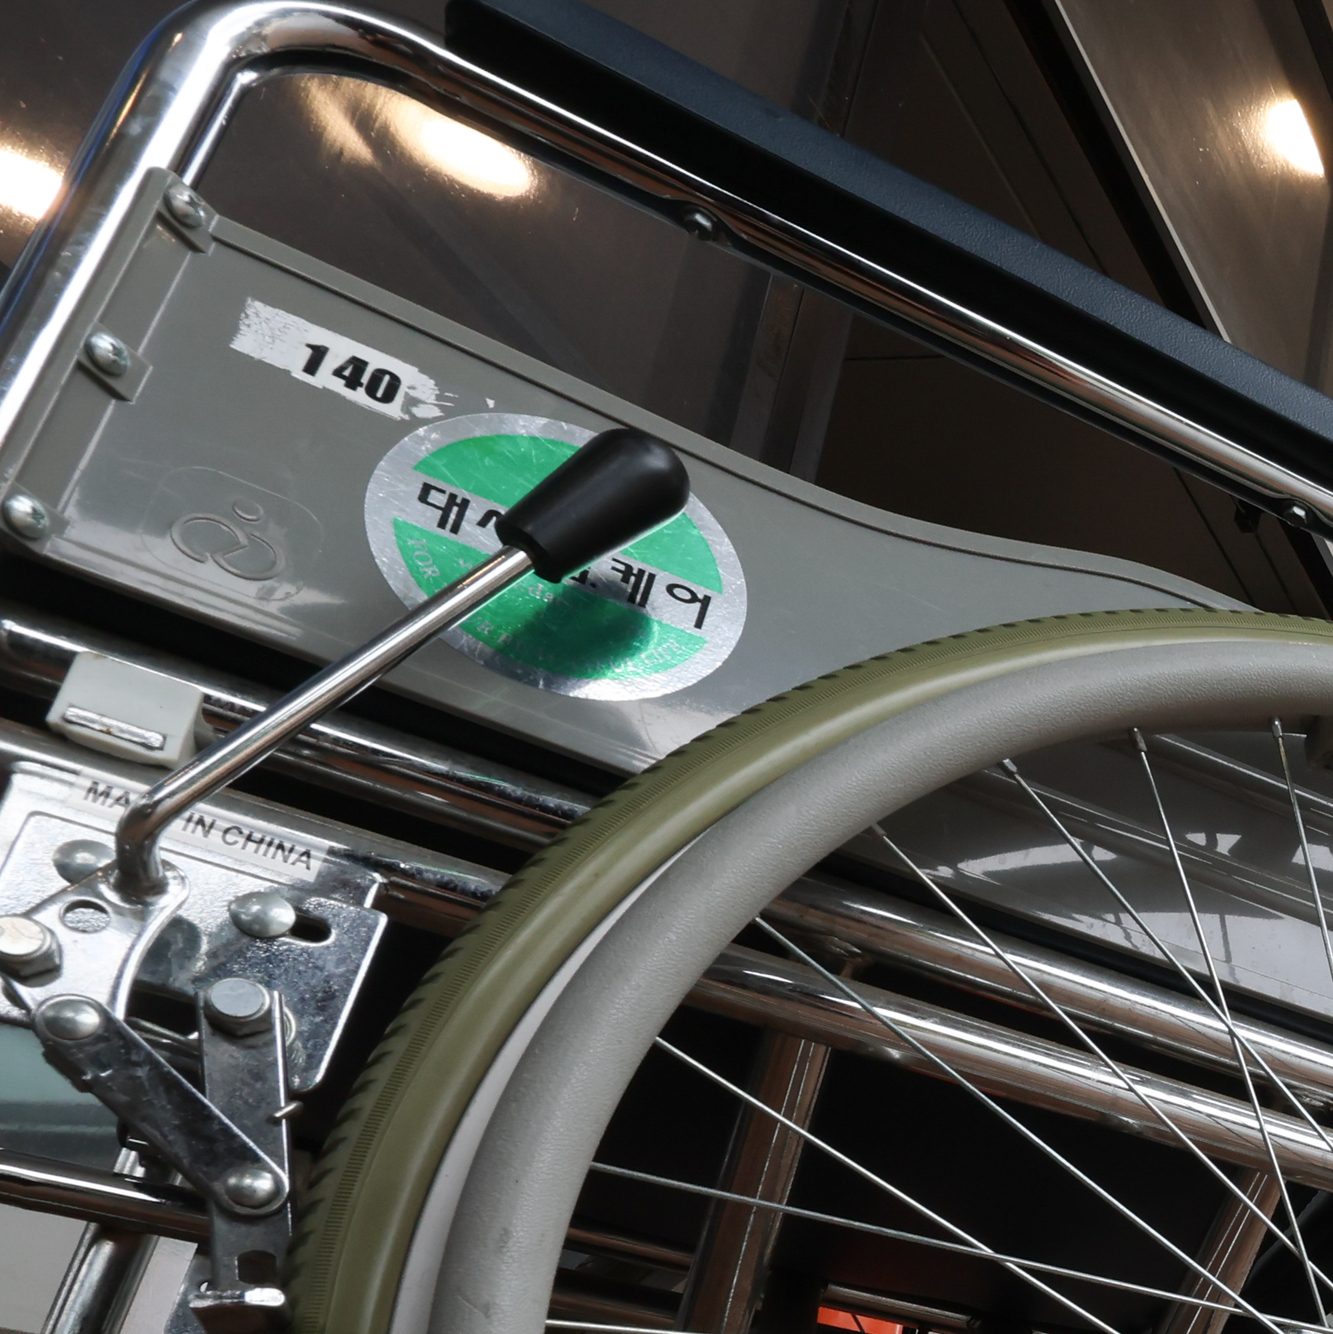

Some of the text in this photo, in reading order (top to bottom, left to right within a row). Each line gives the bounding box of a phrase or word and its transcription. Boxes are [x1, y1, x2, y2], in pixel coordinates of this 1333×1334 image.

[301, 343, 403, 404] 140
[416, 482, 713, 631] 대케어
[85, 781, 313, 871] MA IN CHINA
